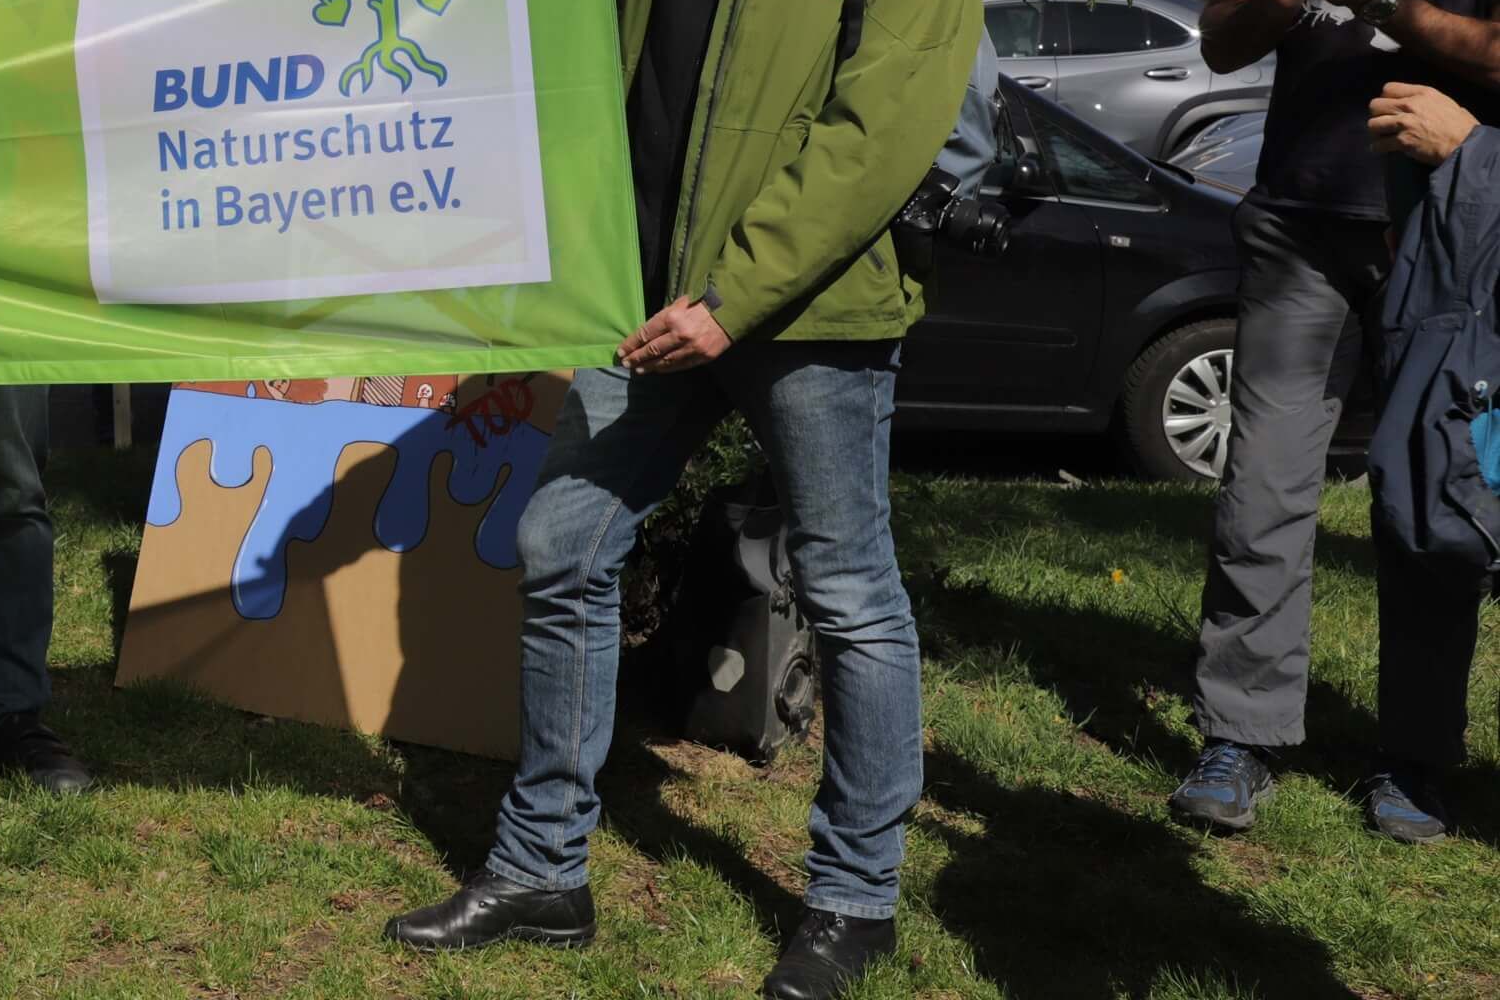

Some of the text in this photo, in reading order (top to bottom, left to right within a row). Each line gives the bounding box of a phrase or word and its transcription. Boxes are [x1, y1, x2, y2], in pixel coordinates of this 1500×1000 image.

[152, 53, 326, 112] BUND
[157, 111, 455, 172] Naturschutz
[161, 166, 461, 234] in Bayern e.V.
